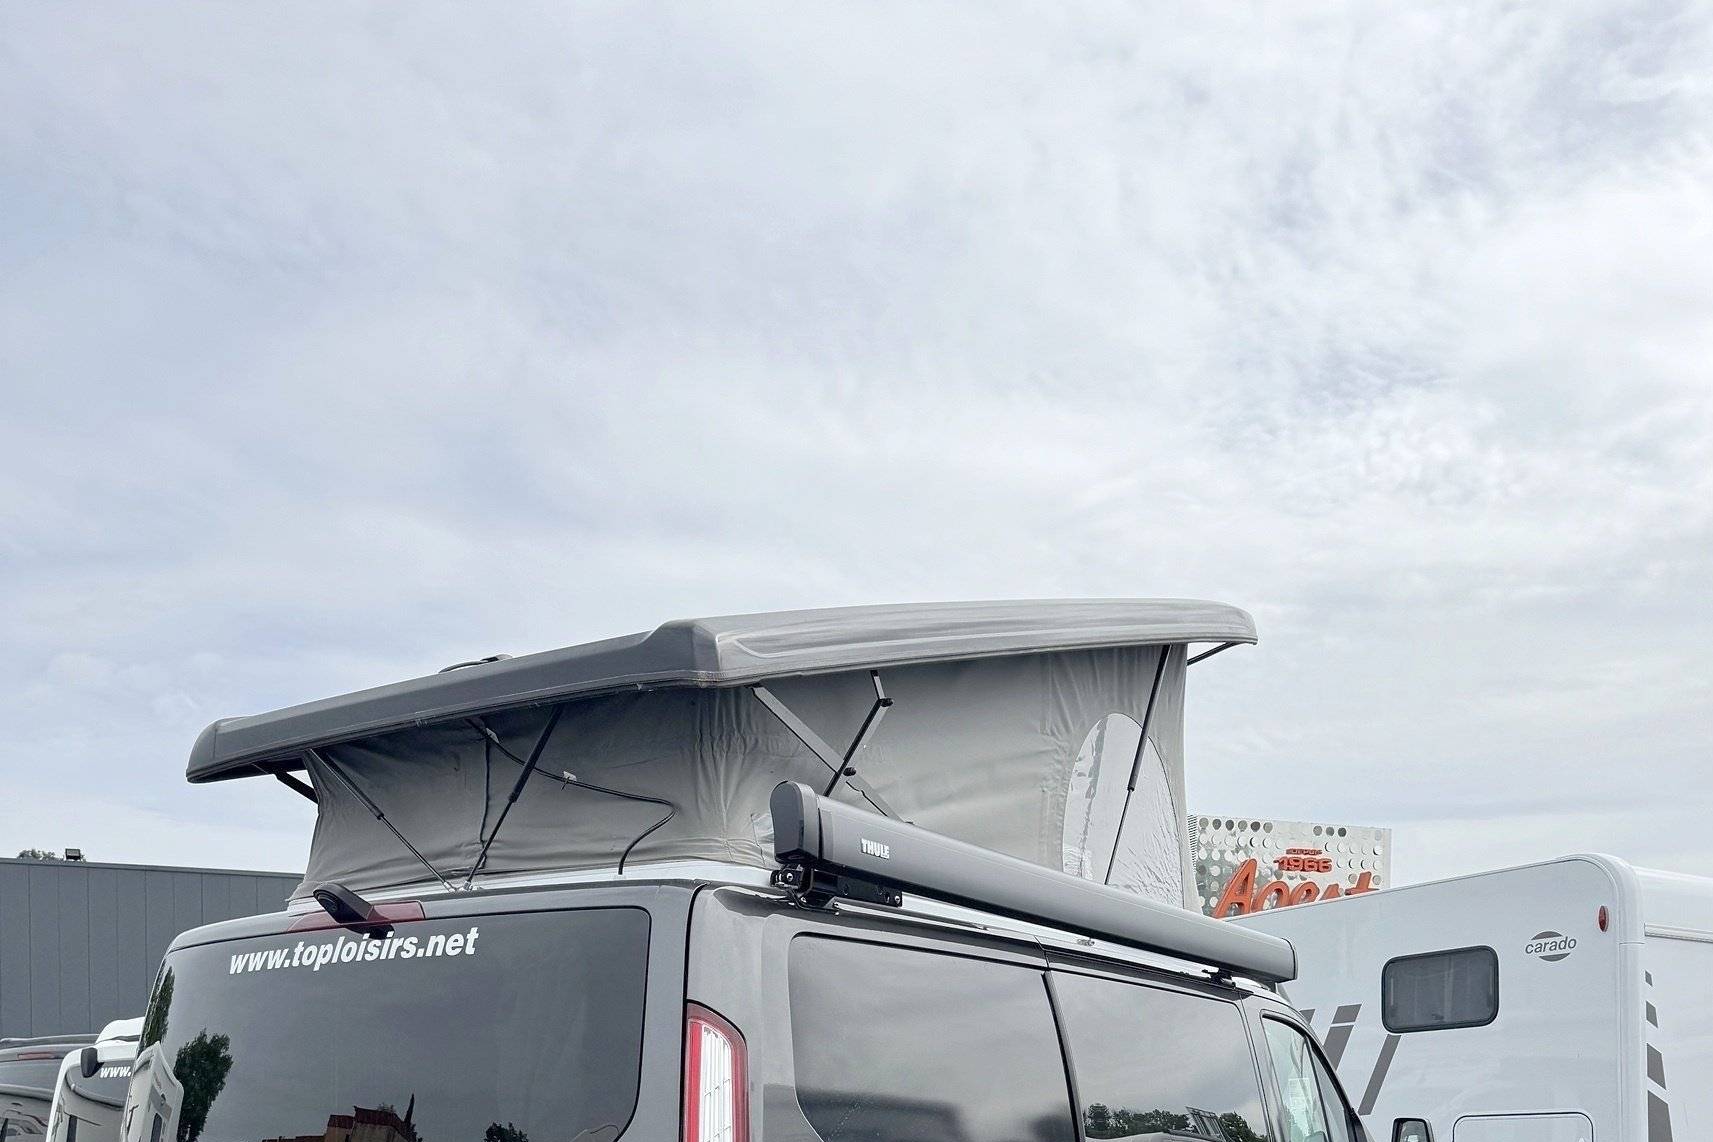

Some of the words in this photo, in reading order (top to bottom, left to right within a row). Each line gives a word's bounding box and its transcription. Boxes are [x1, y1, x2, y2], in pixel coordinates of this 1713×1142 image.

[861, 838, 890, 859] THULE
[1274, 856, 1332, 873] 1966
[229, 927, 479, 974] www.toploisirs.net
[1524, 935, 1577, 955] carado
